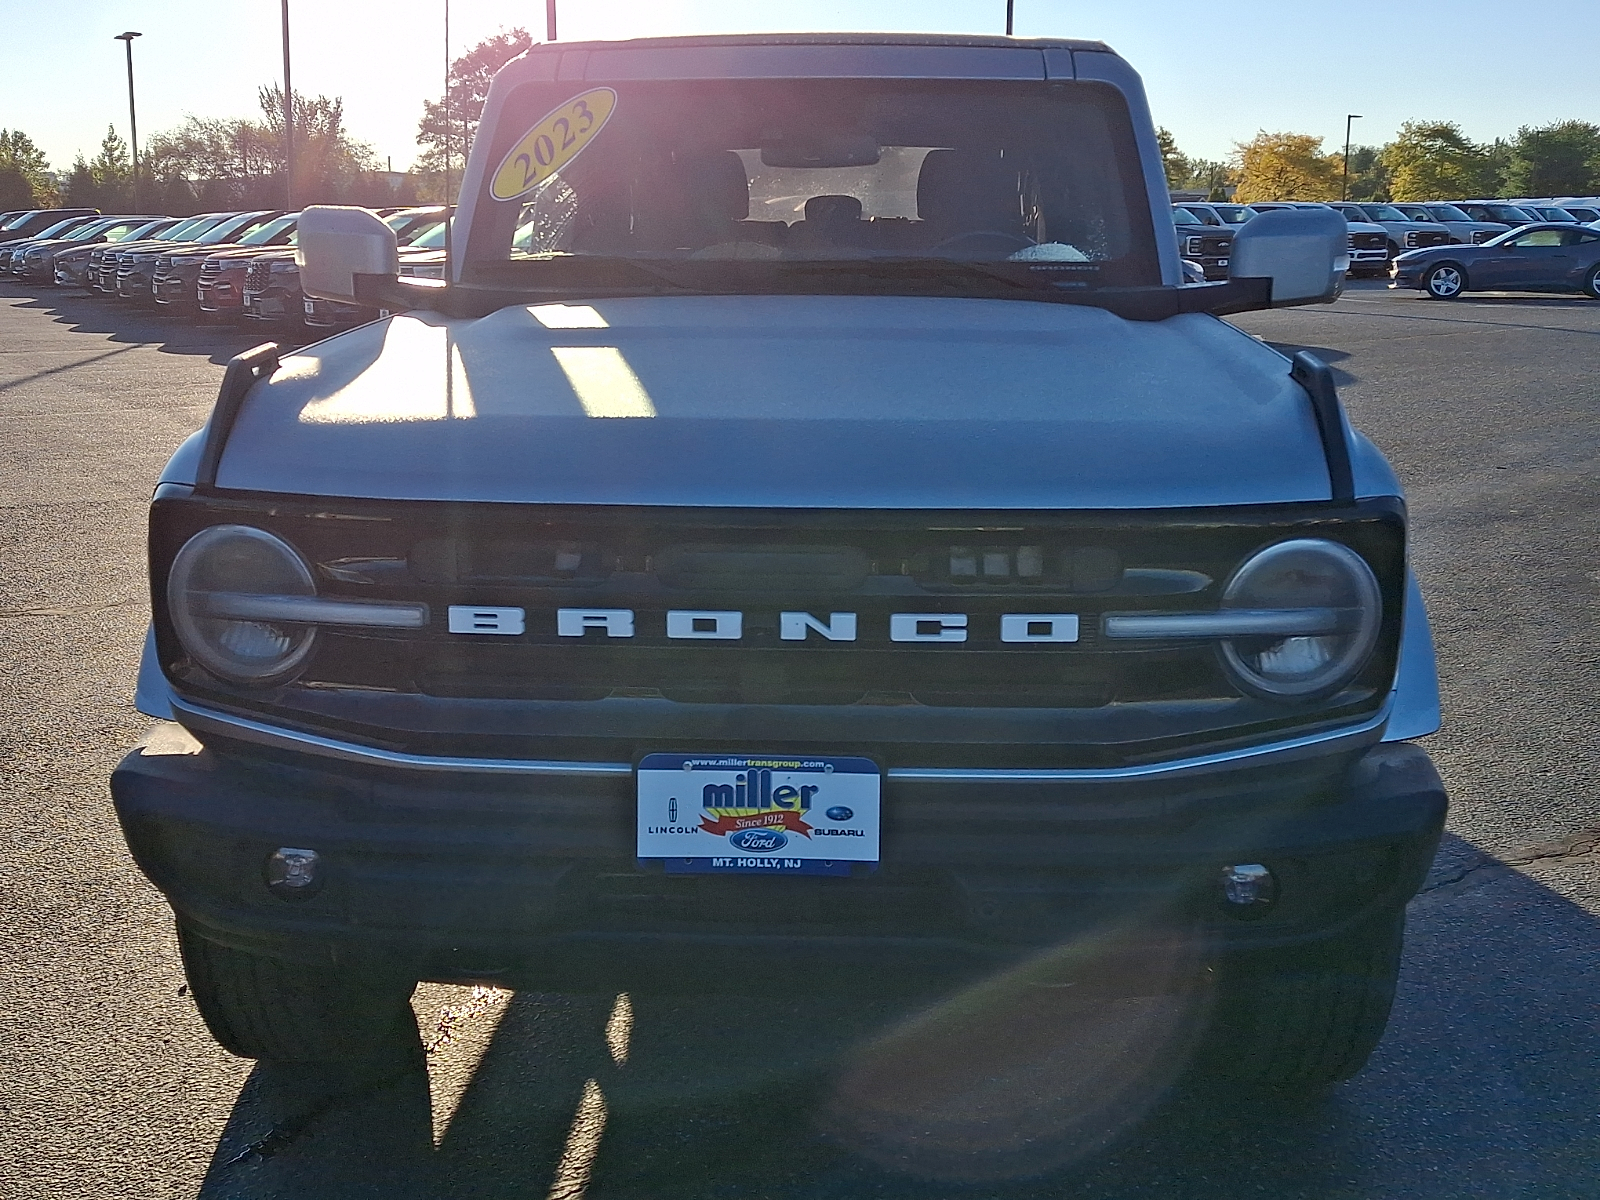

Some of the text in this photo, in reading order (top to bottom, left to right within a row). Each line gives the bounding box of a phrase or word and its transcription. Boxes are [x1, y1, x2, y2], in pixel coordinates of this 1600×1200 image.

[514, 100, 594, 188] 2023
[448, 605, 1080, 643] BRONCO
[691, 758, 825, 769] www.millertransgroup.com
[703, 769, 819, 809] miller
[735, 814, 784, 829] Since 1912
[648, 826, 699, 834] LINCOLN
[814, 828, 864, 837] SUBARU
[741, 831, 775, 849] Ford
[712, 858, 801, 869] MT. HOLLY, NJ
